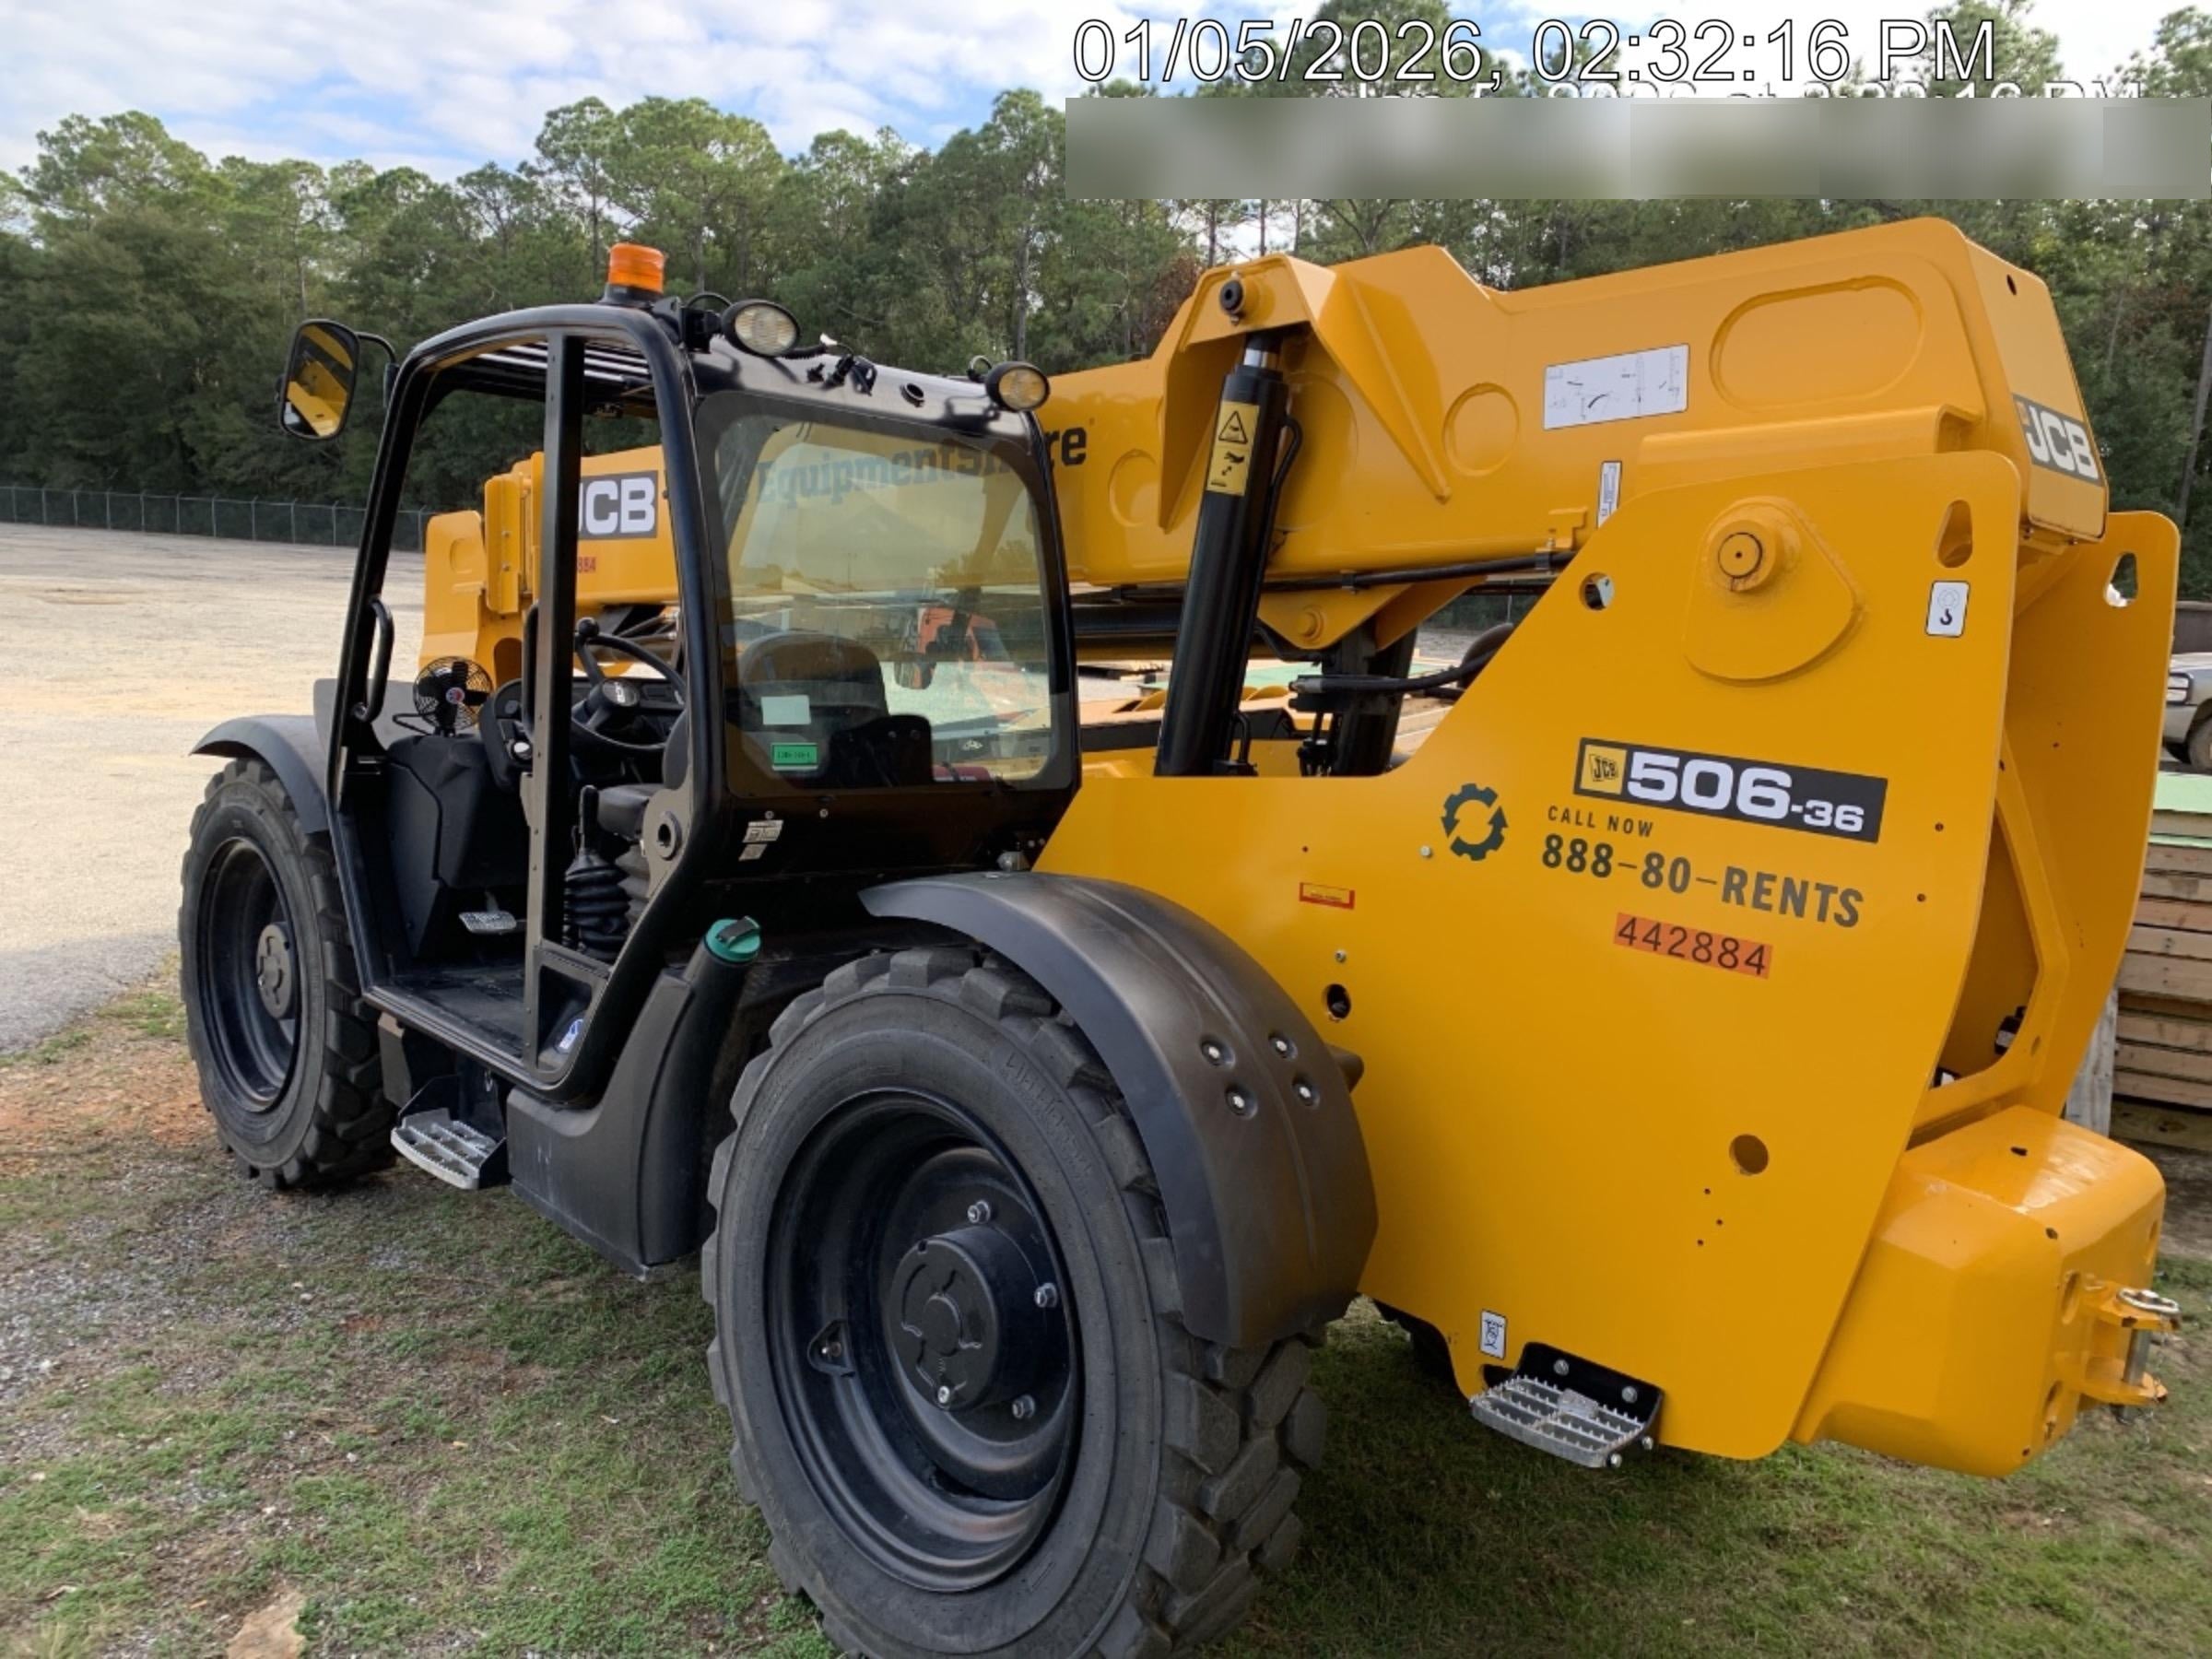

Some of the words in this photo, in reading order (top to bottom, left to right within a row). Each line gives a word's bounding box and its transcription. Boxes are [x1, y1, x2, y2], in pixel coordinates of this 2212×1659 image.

[756, 427, 1087, 508] EquipmentShre
[2026, 405, 2100, 480] JCB
[578, 477, 655, 535] CB
[1593, 755, 1617, 781] JCB
[1627, 751, 1865, 833] 506-36
[1547, 805, 1596, 829] CALL
[1607, 813, 1653, 837] NOW
[1542, 834, 1865, 927] 888-80-RENTS
[1618, 917, 1767, 976] 442884
